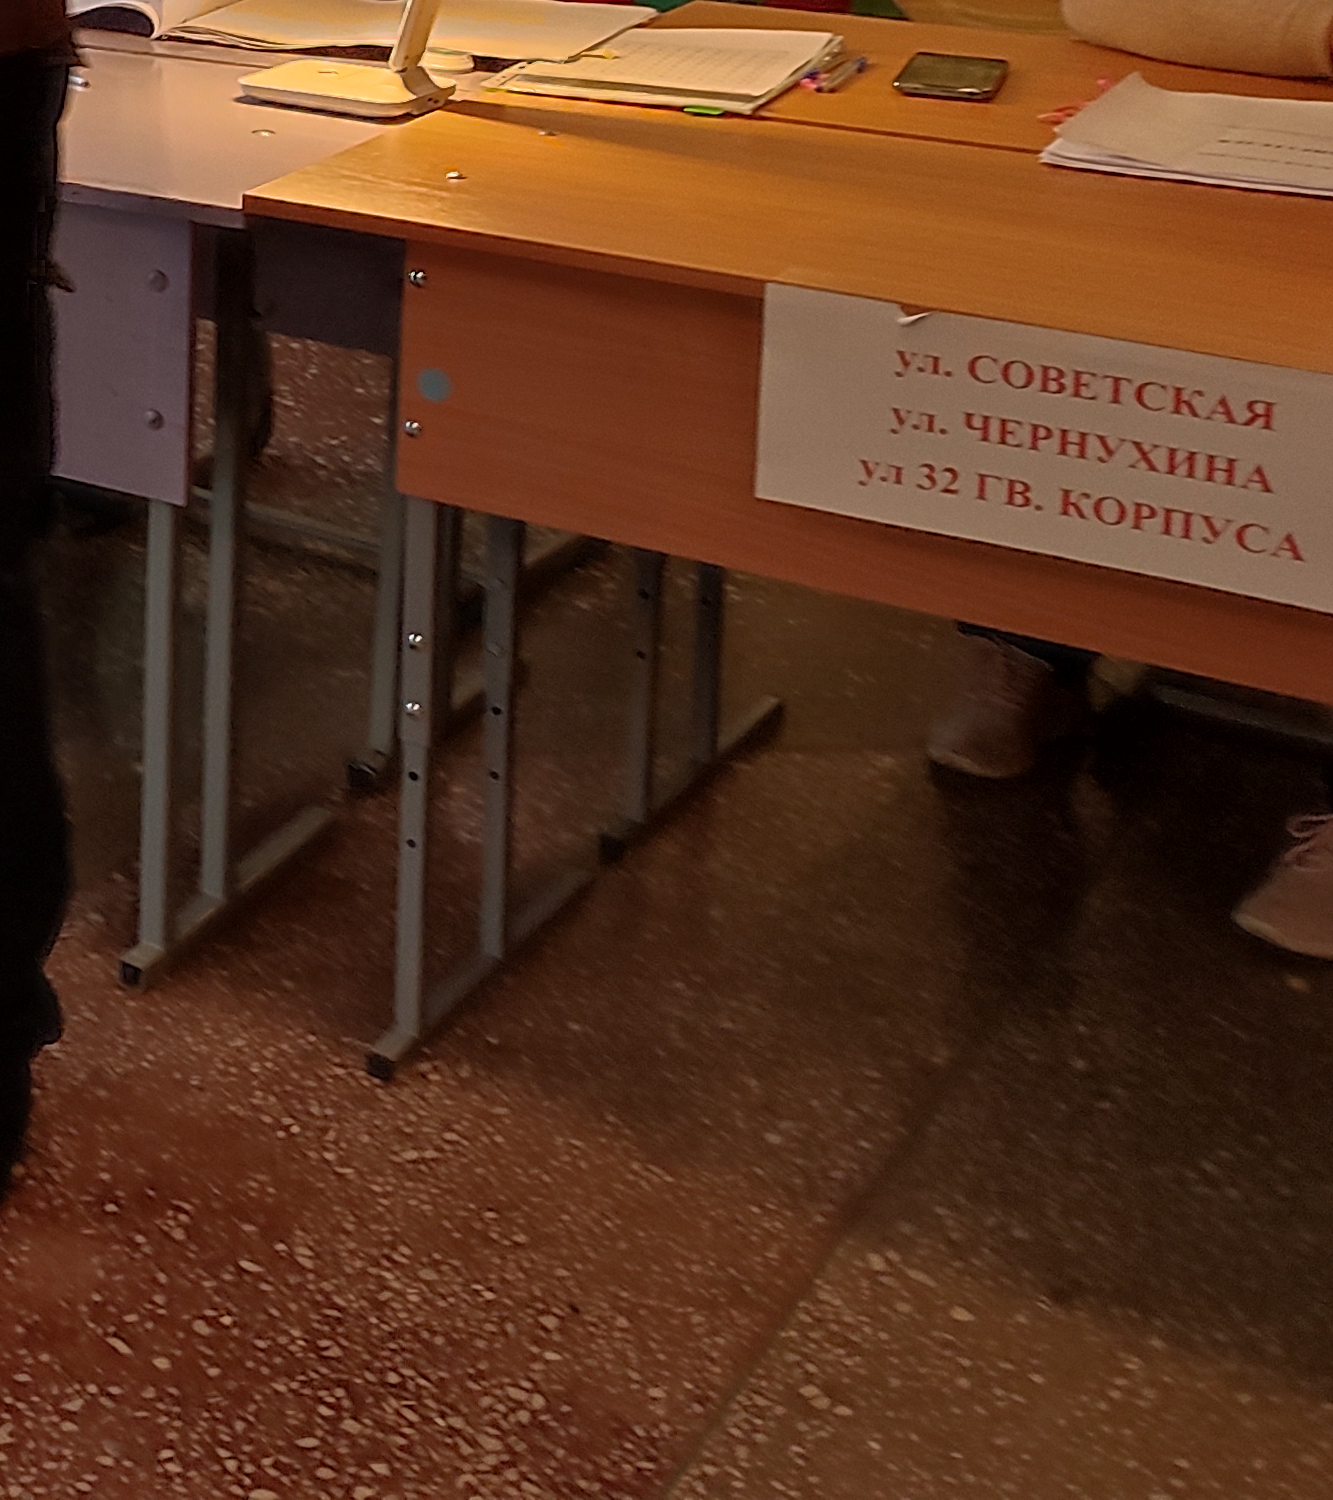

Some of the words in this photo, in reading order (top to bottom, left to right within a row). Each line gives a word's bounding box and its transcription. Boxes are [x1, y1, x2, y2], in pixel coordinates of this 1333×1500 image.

[895, 349, 953, 378] ул.
[967, 354, 1278, 431] СОВЕТСКАЯ
[890, 406, 948, 435] ул.
[963, 411, 1275, 494] ЧЕРНУХИНА
[858, 458, 903, 486] ул
[916, 462, 961, 495] 32
[976, 472, 1044, 512] ГВ.
[1059, 487, 1306, 563] КОРПУСА
